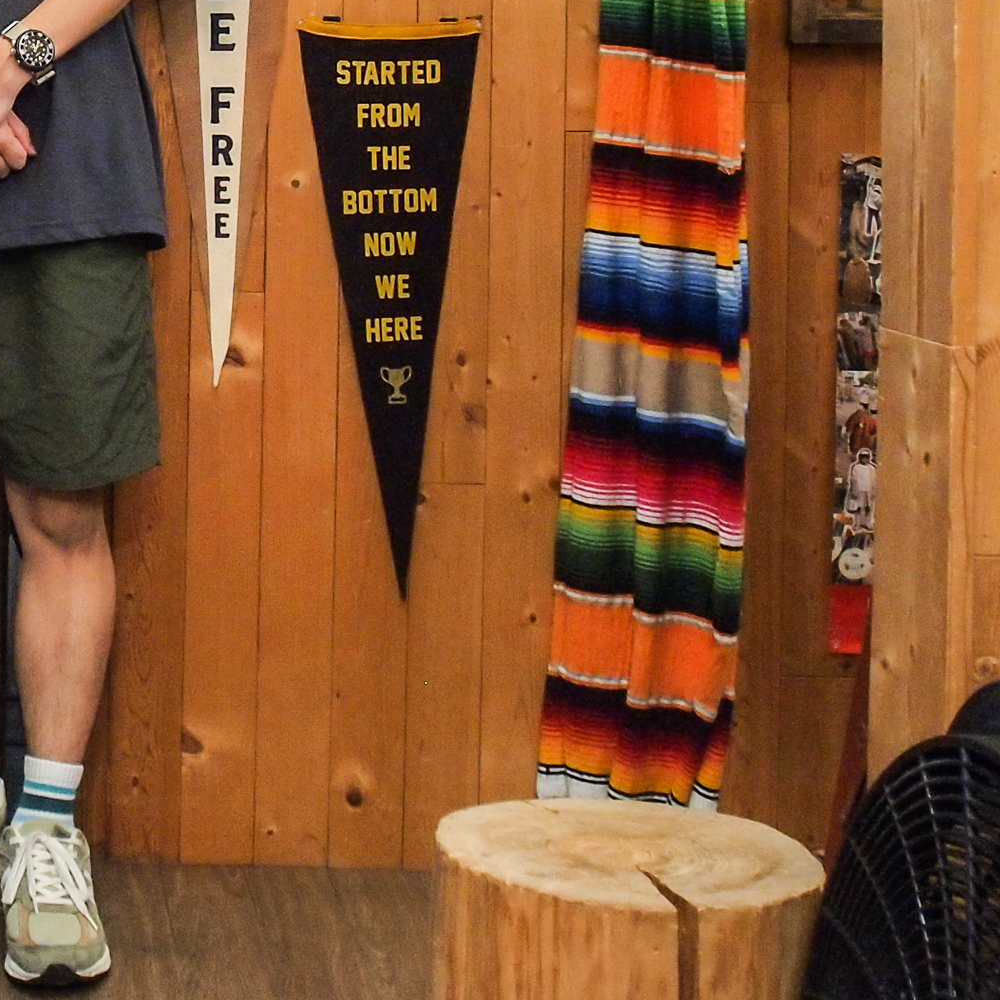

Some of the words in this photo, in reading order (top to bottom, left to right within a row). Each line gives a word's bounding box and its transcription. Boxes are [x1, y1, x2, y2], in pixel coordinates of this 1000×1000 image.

[336, 59, 442, 85] STARTED
[357, 103, 421, 128] FROM
[210, 86, 236, 239] FREE
[367, 146, 411, 171] THE
[342, 187, 438, 215] BOTTOM
[364, 231, 417, 257] NOW
[375, 273, 411, 300] WE
[365, 315, 424, 343] HERE
